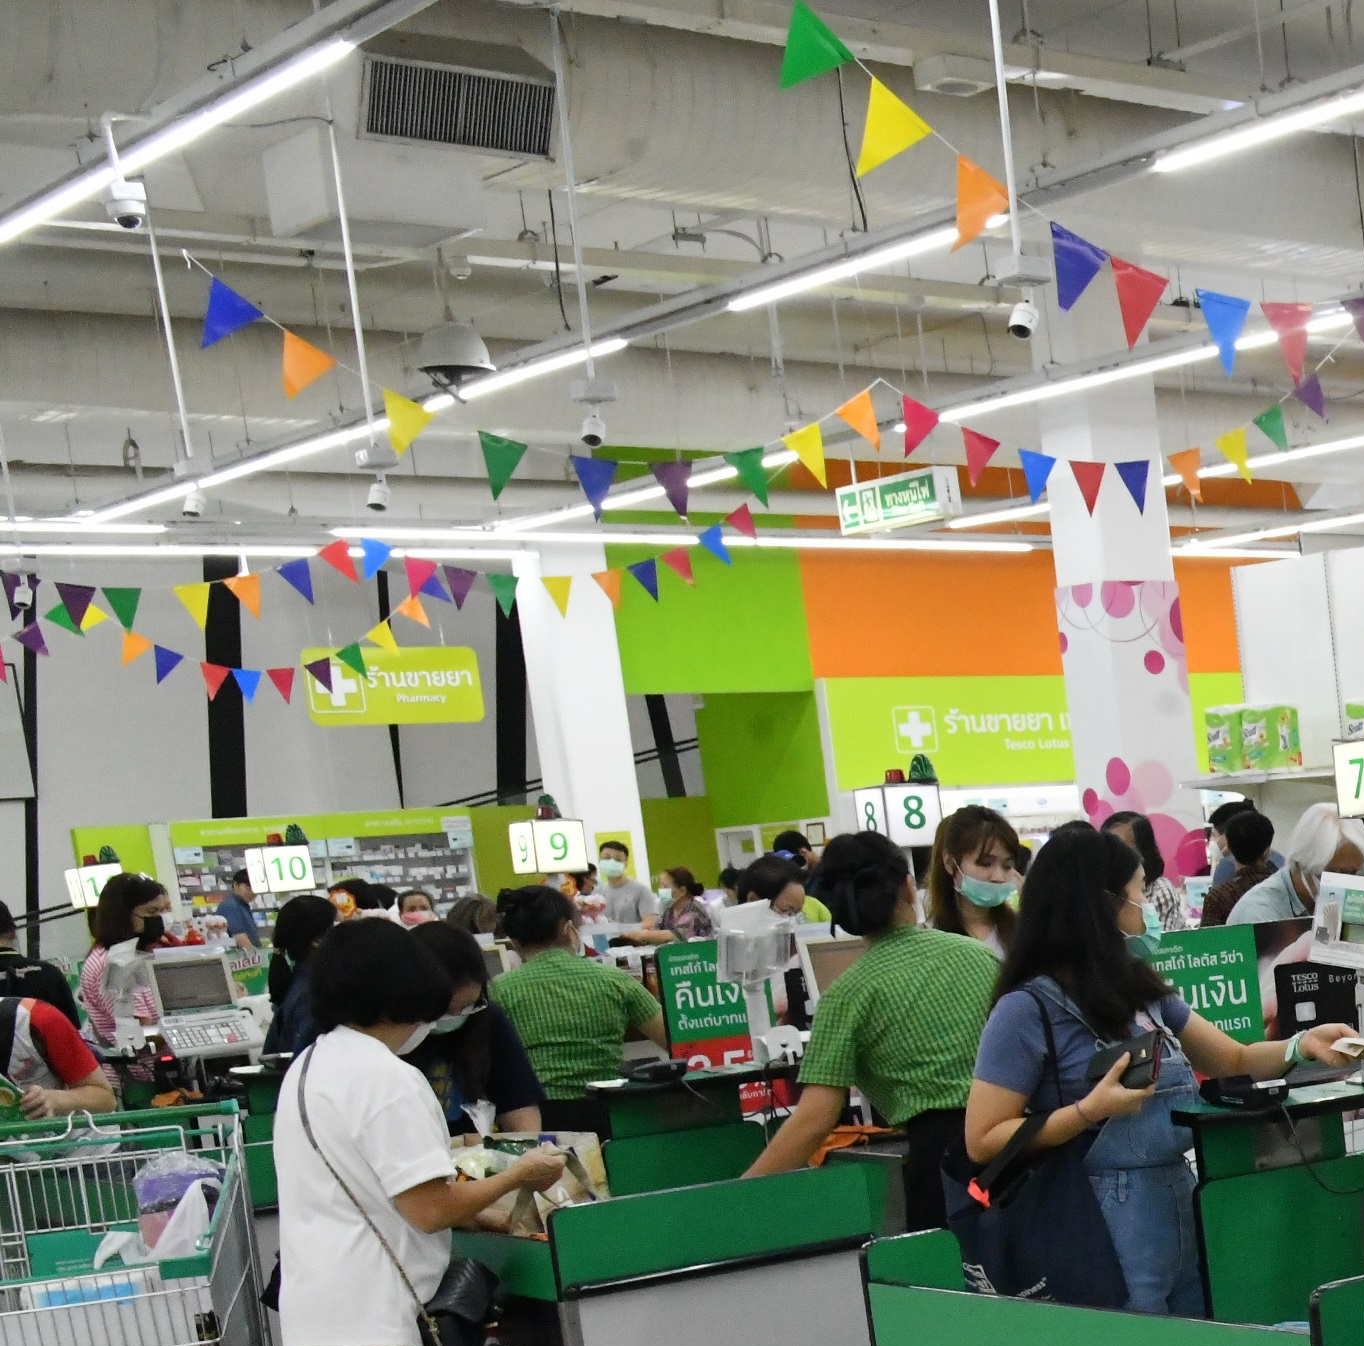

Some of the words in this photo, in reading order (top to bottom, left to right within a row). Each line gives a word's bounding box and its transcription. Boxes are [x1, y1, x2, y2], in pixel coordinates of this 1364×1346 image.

[367, 666, 473, 688] ร้านขายยา
[396, 694, 446, 704] Pharmacy
[945, 708, 1051, 734] ร้านขายยา
[1005, 738, 1034, 750] Tesco
[1039, 737, 1069, 750] Lotus
[1349, 758, 1364, 799] 7
[864, 801, 877, 832] 8
[903, 795, 926, 830] 8
[518, 834, 529, 864] 9
[550, 832, 568, 861] 9
[271, 855, 307, 882] 10
[670, 961, 701, 976] เทสโก้
[1188, 952, 1219, 968] โลตัส
[1221, 950, 1244, 964] วีซ่า
[1291, 972, 1318, 982] TESCO
[1293, 981, 1319, 993] Lotus
